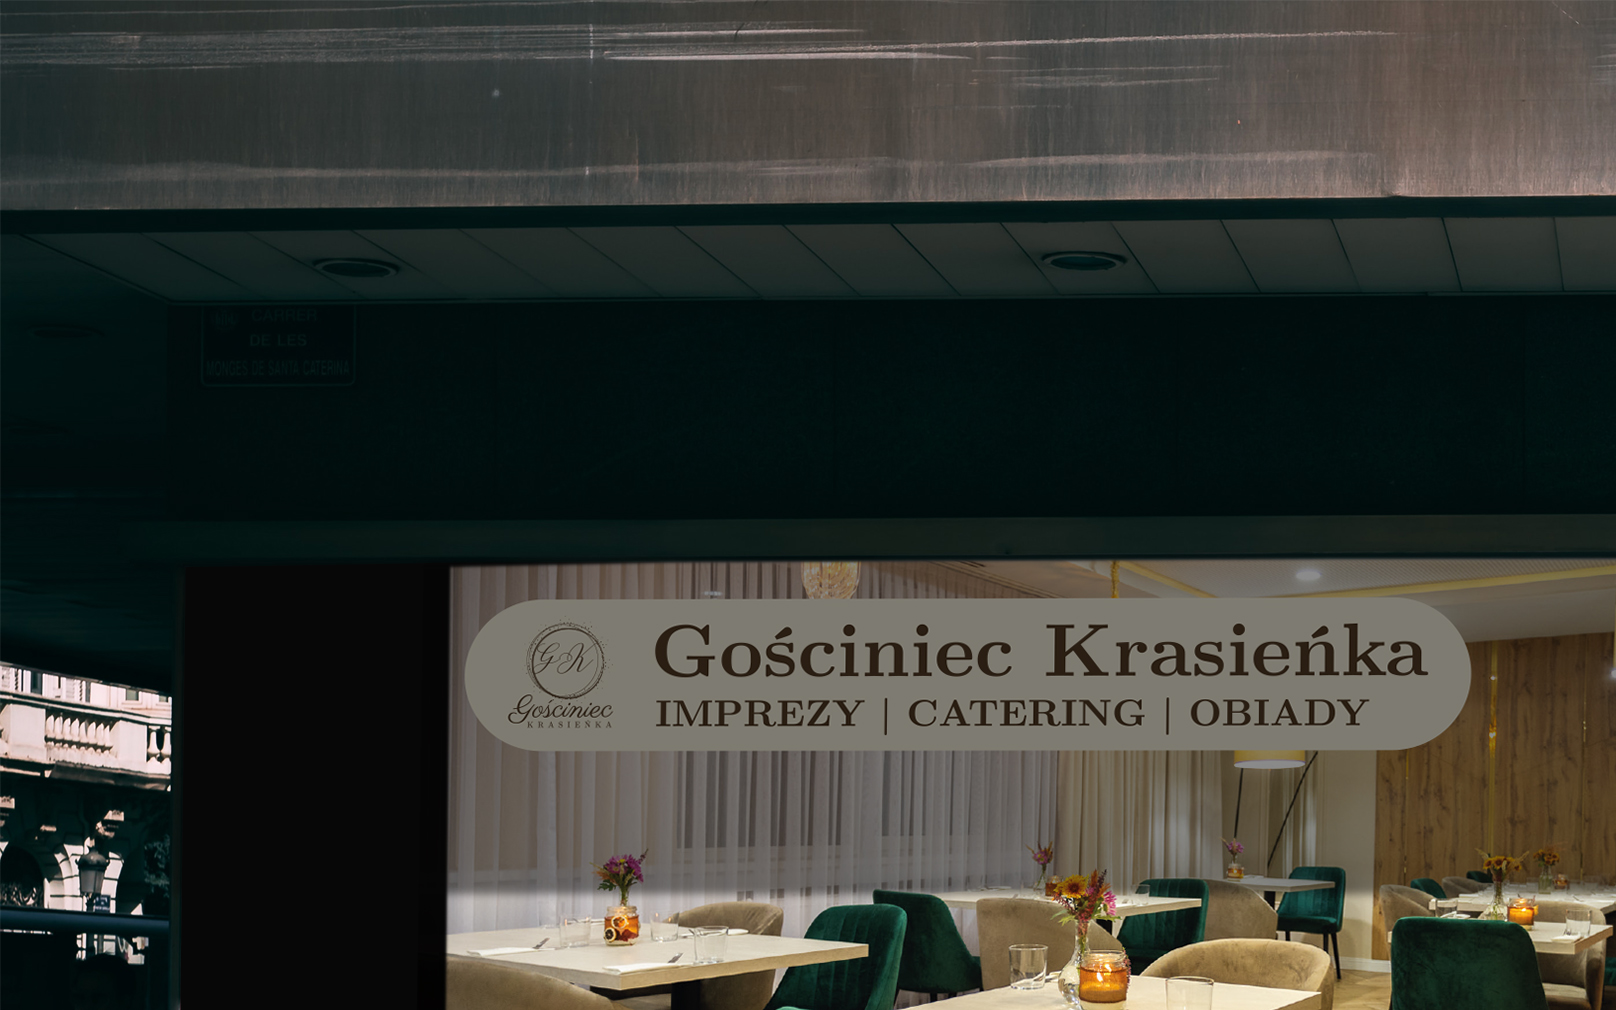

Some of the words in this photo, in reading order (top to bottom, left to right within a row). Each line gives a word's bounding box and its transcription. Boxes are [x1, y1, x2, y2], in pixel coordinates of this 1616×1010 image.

[251, 309, 317, 322] CARRER
[249, 334, 271, 347] DE
[277, 334, 308, 347] LES
[206, 360, 249, 376] MONGES
[251, 360, 265, 376] DE
[267, 360, 301, 376] SANTA
[302, 359, 350, 376] CATERINA
[654, 623, 1013, 678] Gościniec
[1045, 622, 1429, 677] Krasieńka
[508, 694, 614, 724] Gościniec
[655, 699, 866, 728] IMPREZY
[908, 698, 1146, 727] CATERING
[1190, 698, 1370, 727] OBIADY
[526, 720, 613, 729] KRASIEŃKA
